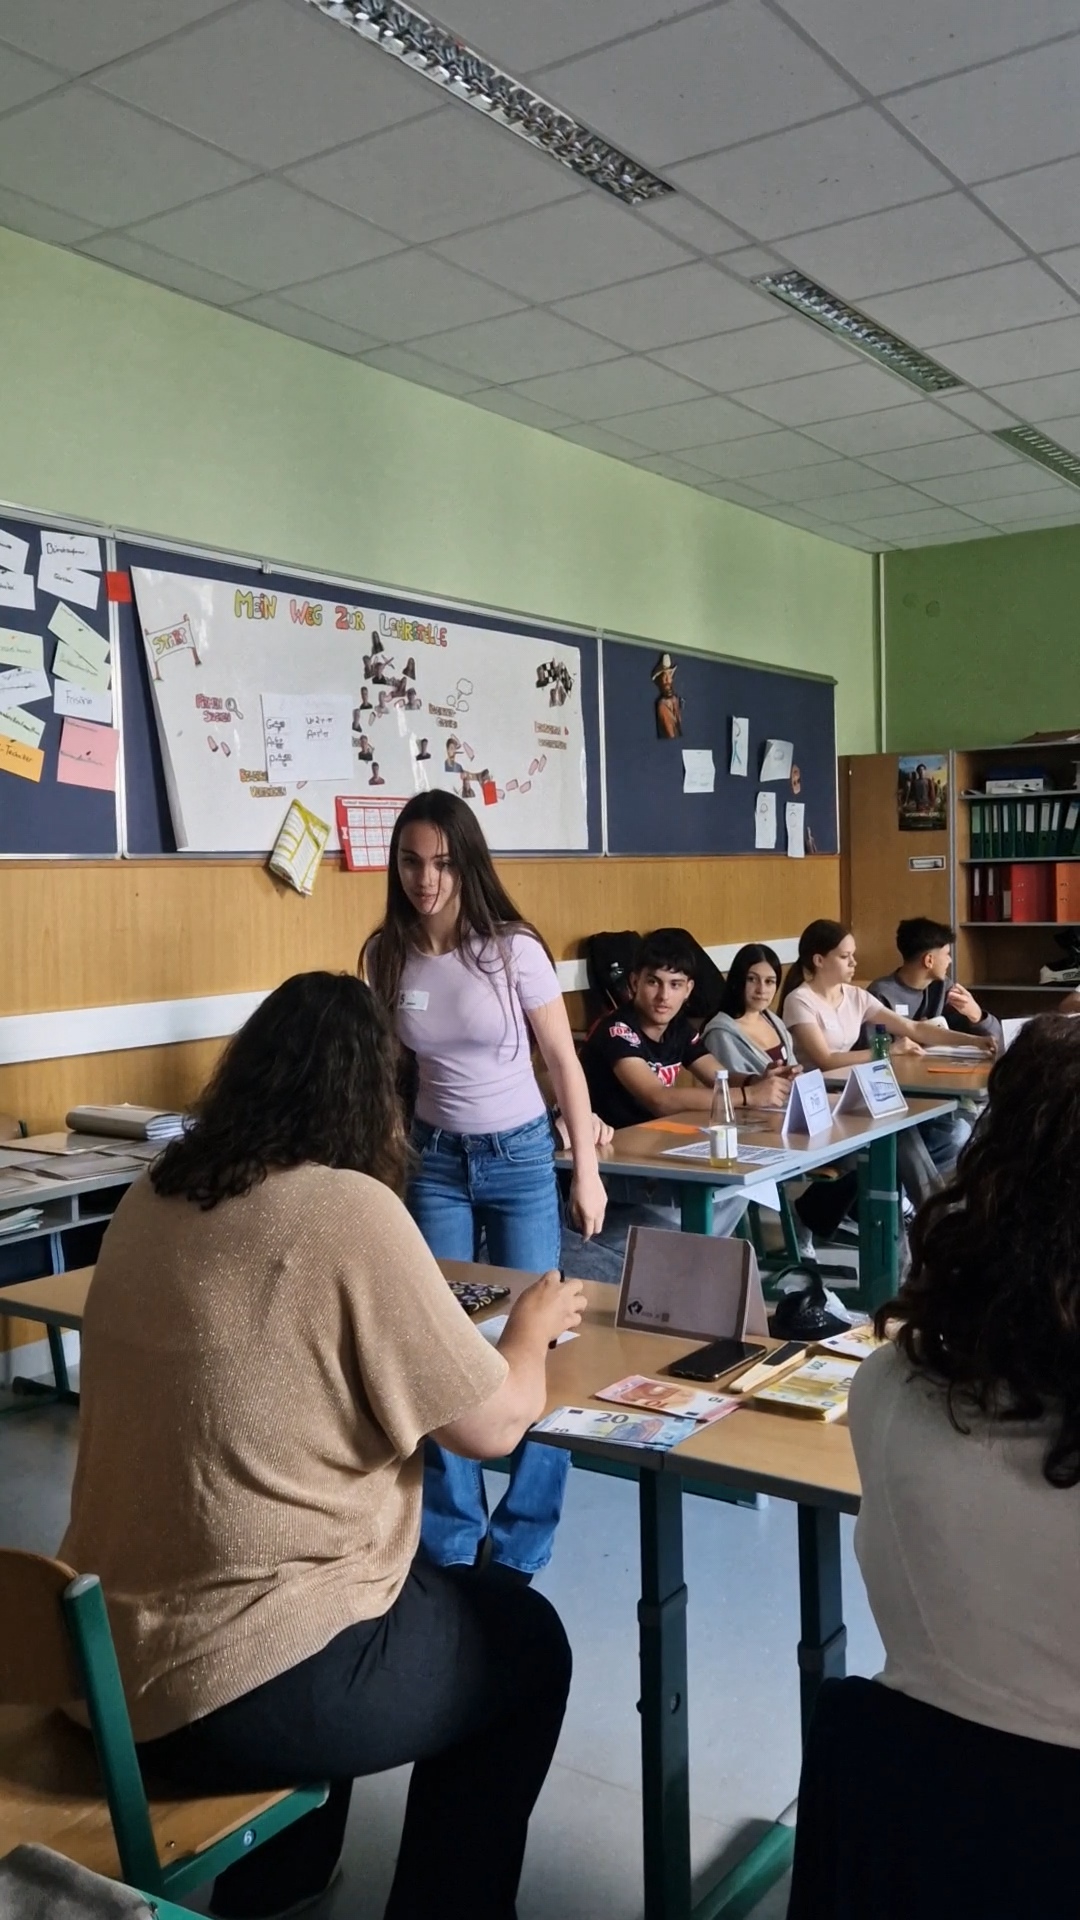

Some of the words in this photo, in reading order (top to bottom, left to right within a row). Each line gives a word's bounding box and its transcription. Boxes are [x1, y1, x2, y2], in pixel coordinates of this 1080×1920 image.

[289, 598, 323, 627] WEG
[335, 605, 366, 631] ZUR
[379, 612, 448, 648] LEHRSTELLE
[708, 1395, 725, 1404] 10
[594, 1412, 629, 1424] 20
[243, 1829, 252, 1846] 6
